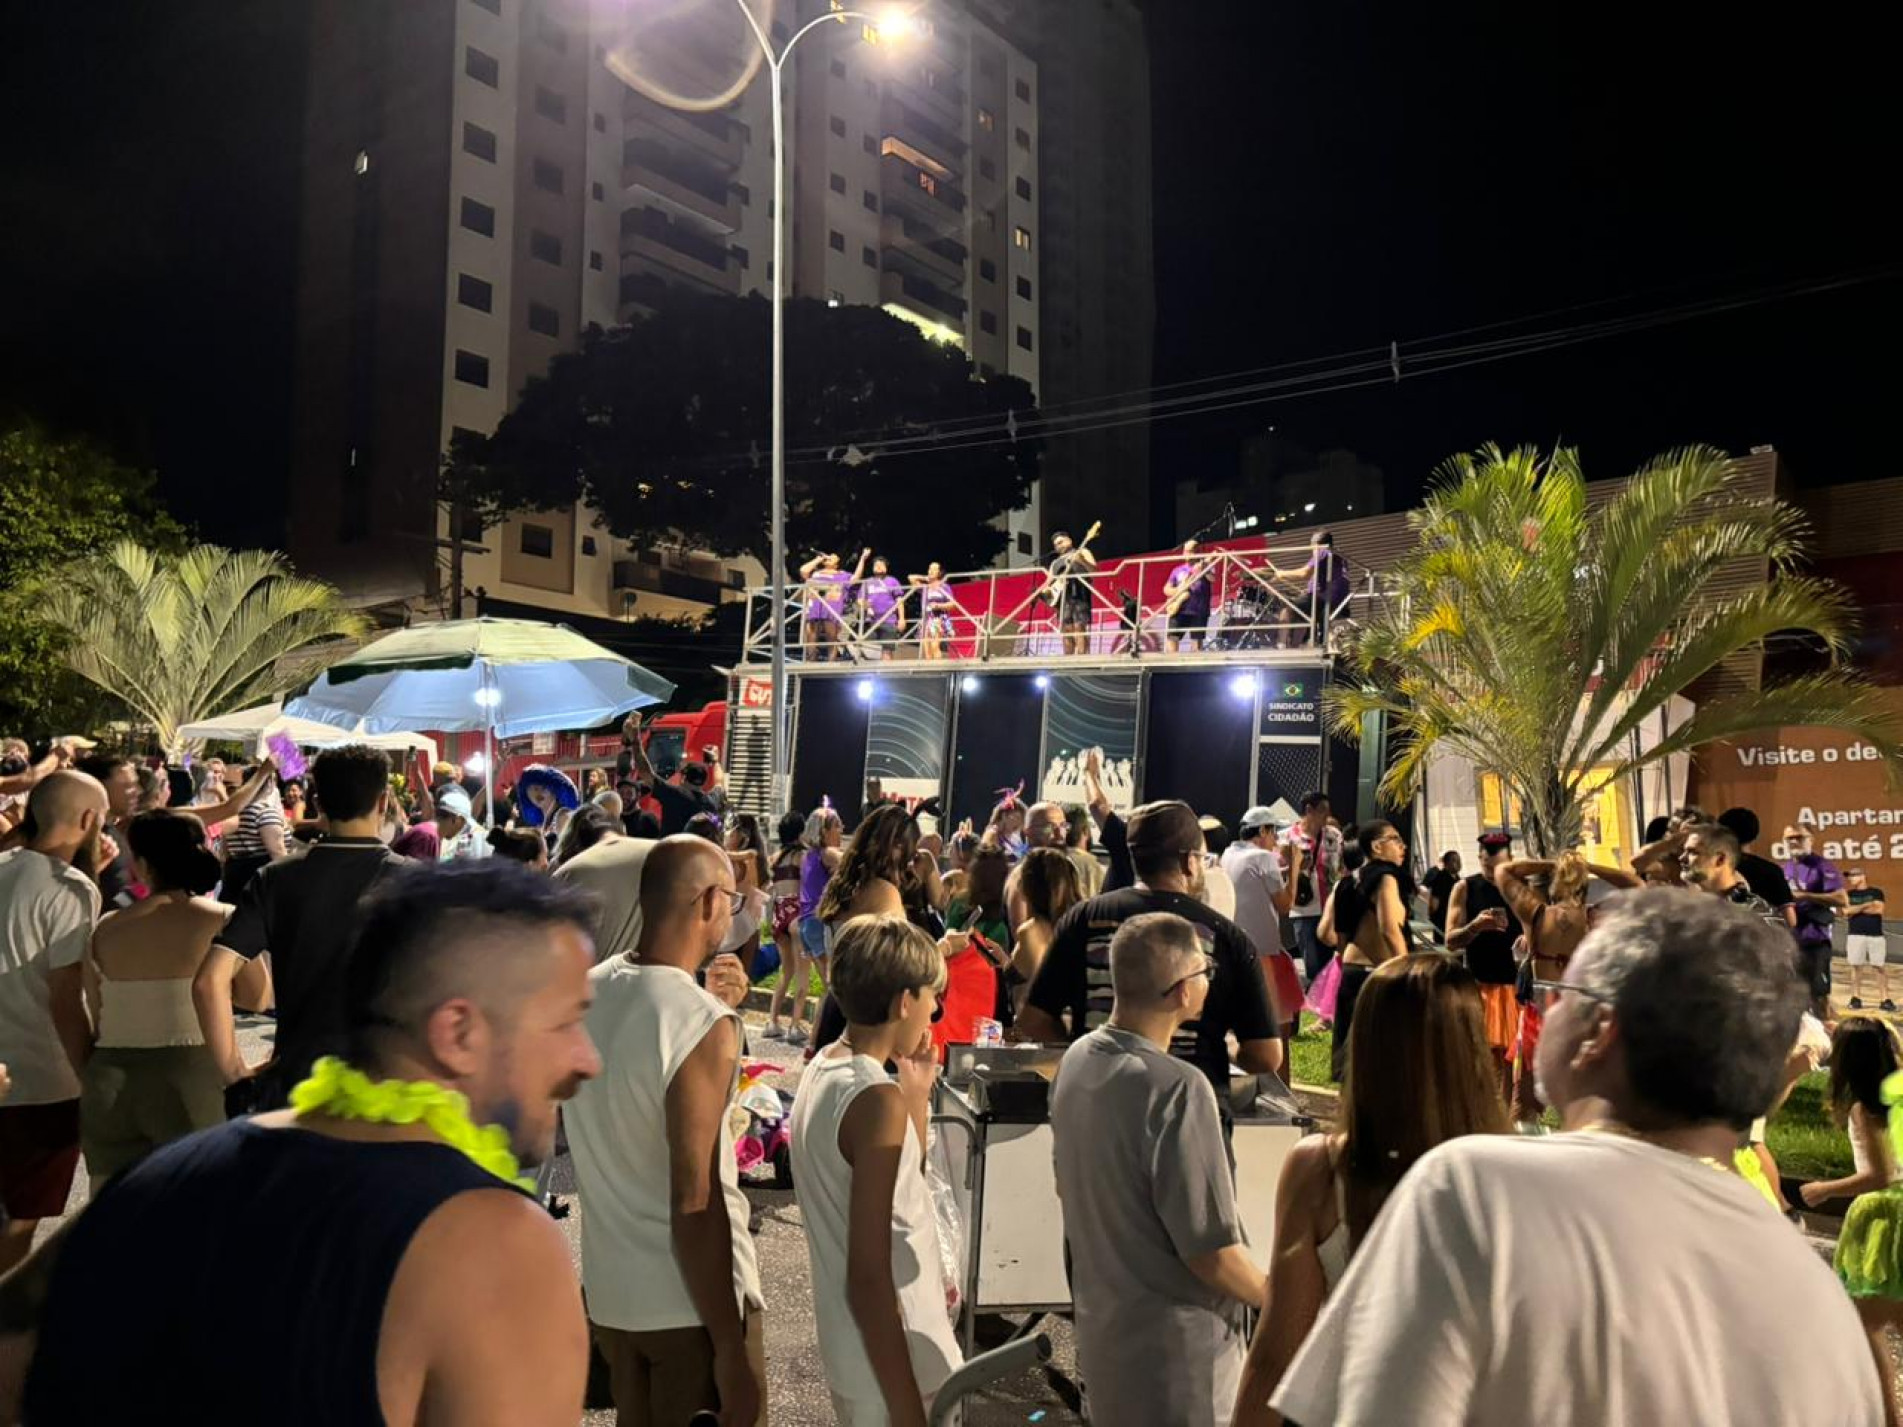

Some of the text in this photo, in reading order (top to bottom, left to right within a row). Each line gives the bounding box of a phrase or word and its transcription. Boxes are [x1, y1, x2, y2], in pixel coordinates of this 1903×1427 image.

[1268, 702, 1314, 710] SINDICATO
[1267, 711, 1315, 721] CIDADÃO
[1737, 742, 1882, 766] Visite o de
[1823, 834, 1882, 859] até
